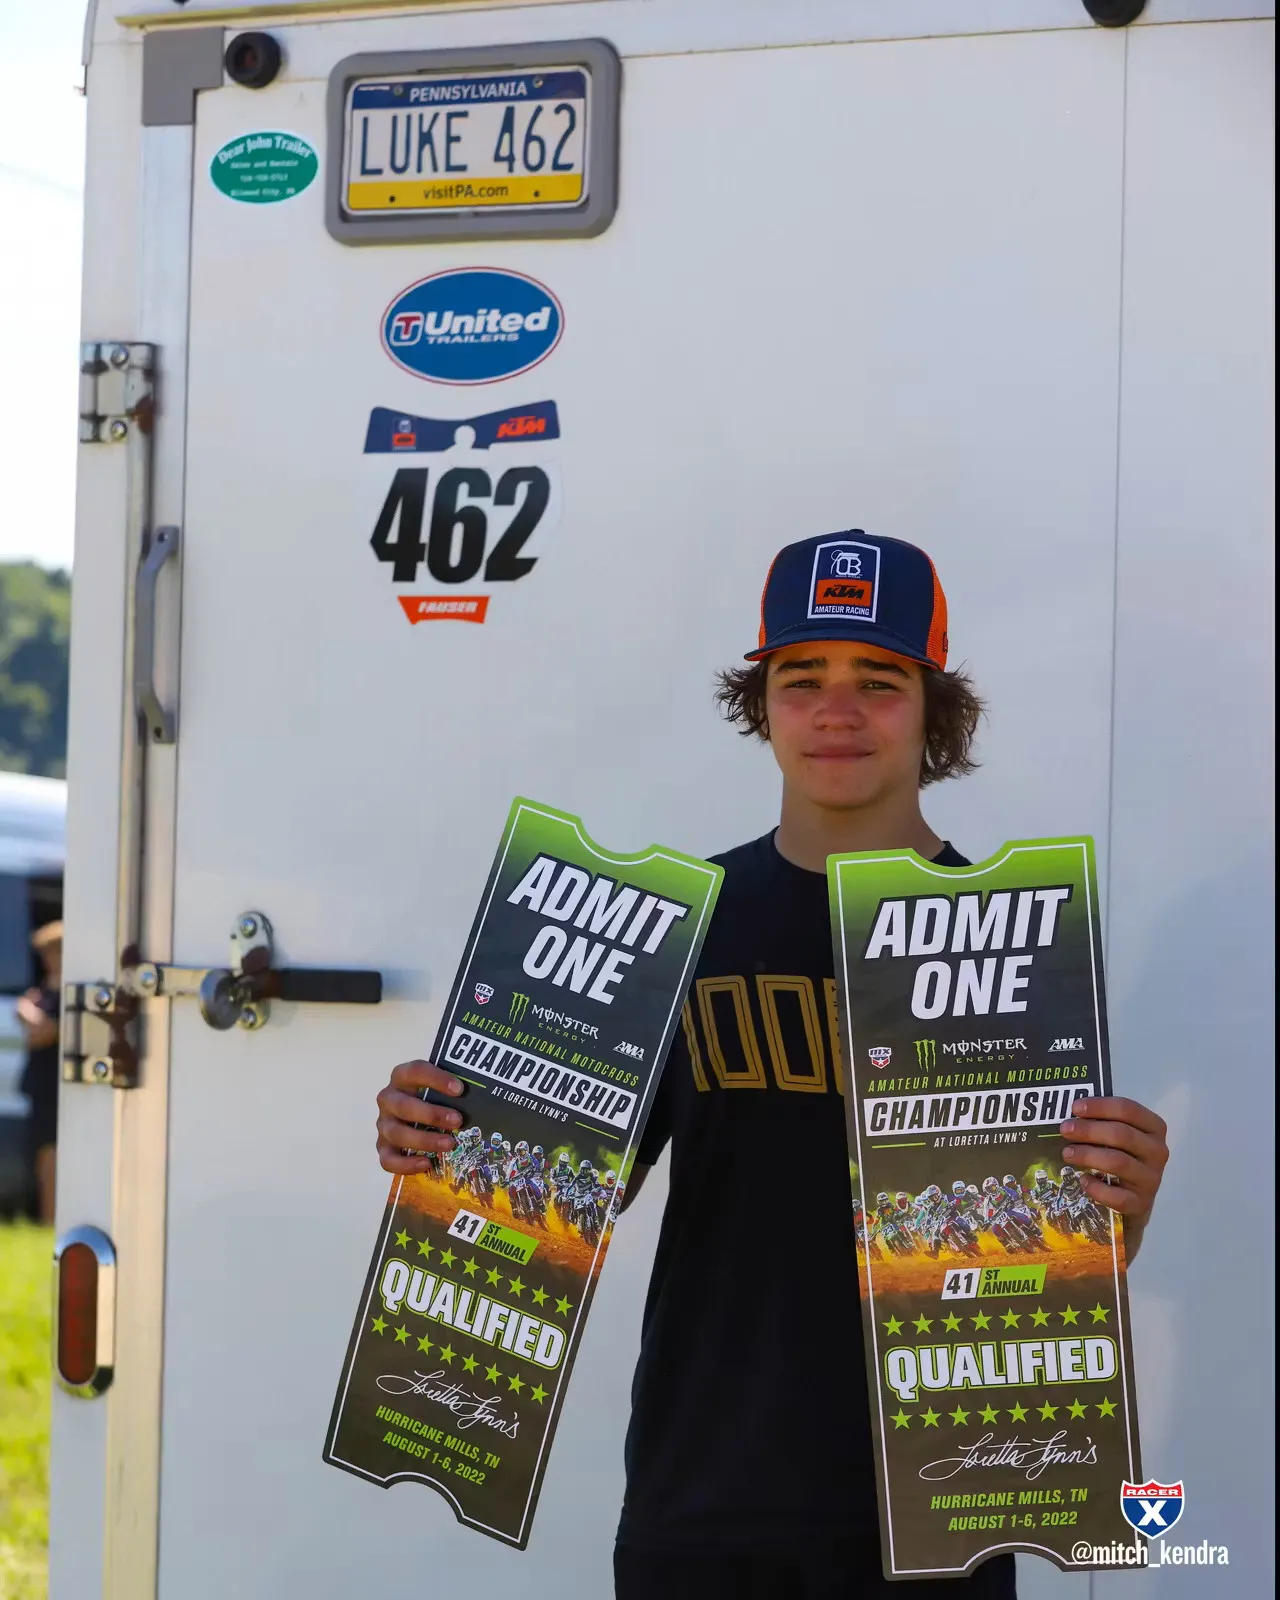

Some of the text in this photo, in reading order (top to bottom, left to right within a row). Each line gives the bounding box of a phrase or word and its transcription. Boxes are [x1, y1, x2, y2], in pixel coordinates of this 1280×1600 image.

[409, 81, 527, 102] PENNSYLVANIA
[360, 103, 577, 176] LUKE 462
[423, 184, 509, 200] visitPA.com
[424, 307, 551, 335] United
[426, 333, 519, 344] TRAILERS
[497, 416, 546, 438] KTM
[370, 465, 551, 584] 462
[823, 584, 865, 600] KTM
[814, 606, 870, 616] AMATEUR RACING
[506, 856, 687, 955] ADMIT
[864, 888, 1069, 960] ADMIT
[522, 925, 636, 1005] ONE
[911, 955, 1034, 1020] ONE
[531, 1004, 599, 1040] MONSTER
[538, 1022, 586, 1044] ENERGY
[461, 1011, 639, 1087] AMATEUR NATIONAL MOTOCROSS
[942, 1038, 1027, 1055] MONSTER
[1048, 1038, 1085, 1052] AMA
[956, 1054, 1015, 1064] ENERGY
[449, 1033, 632, 1120] CHAMPIONSHIP
[868, 1065, 1089, 1093] AMATEUR NATIONAL MOTOCROSS
[491, 1086, 569, 1122] AT LORETTA LYNN'S
[934, 1132, 1027, 1148] AT LORETTA LYNN'S
[454, 1214, 480, 1238] 41
[487, 1224, 501, 1236] ST
[480, 1235, 527, 1262] ANNUAL
[946, 1272, 974, 1294] 41
[985, 1269, 999, 1279] ST
[982, 1279, 1038, 1295] ANNUAL
[380, 1259, 566, 1369] QUALIFIED
[886, 1337, 1117, 1401] QUALIFIED
[375, 1405, 501, 1469] HURRICANE MILLS, TN
[382, 1431, 486, 1485] AUGUST 1-6, 2022
[930, 1488, 1088, 1510] HURRICANE MILLS, TN
[948, 1511, 1078, 1531] AUGUST 1-6, 2022
